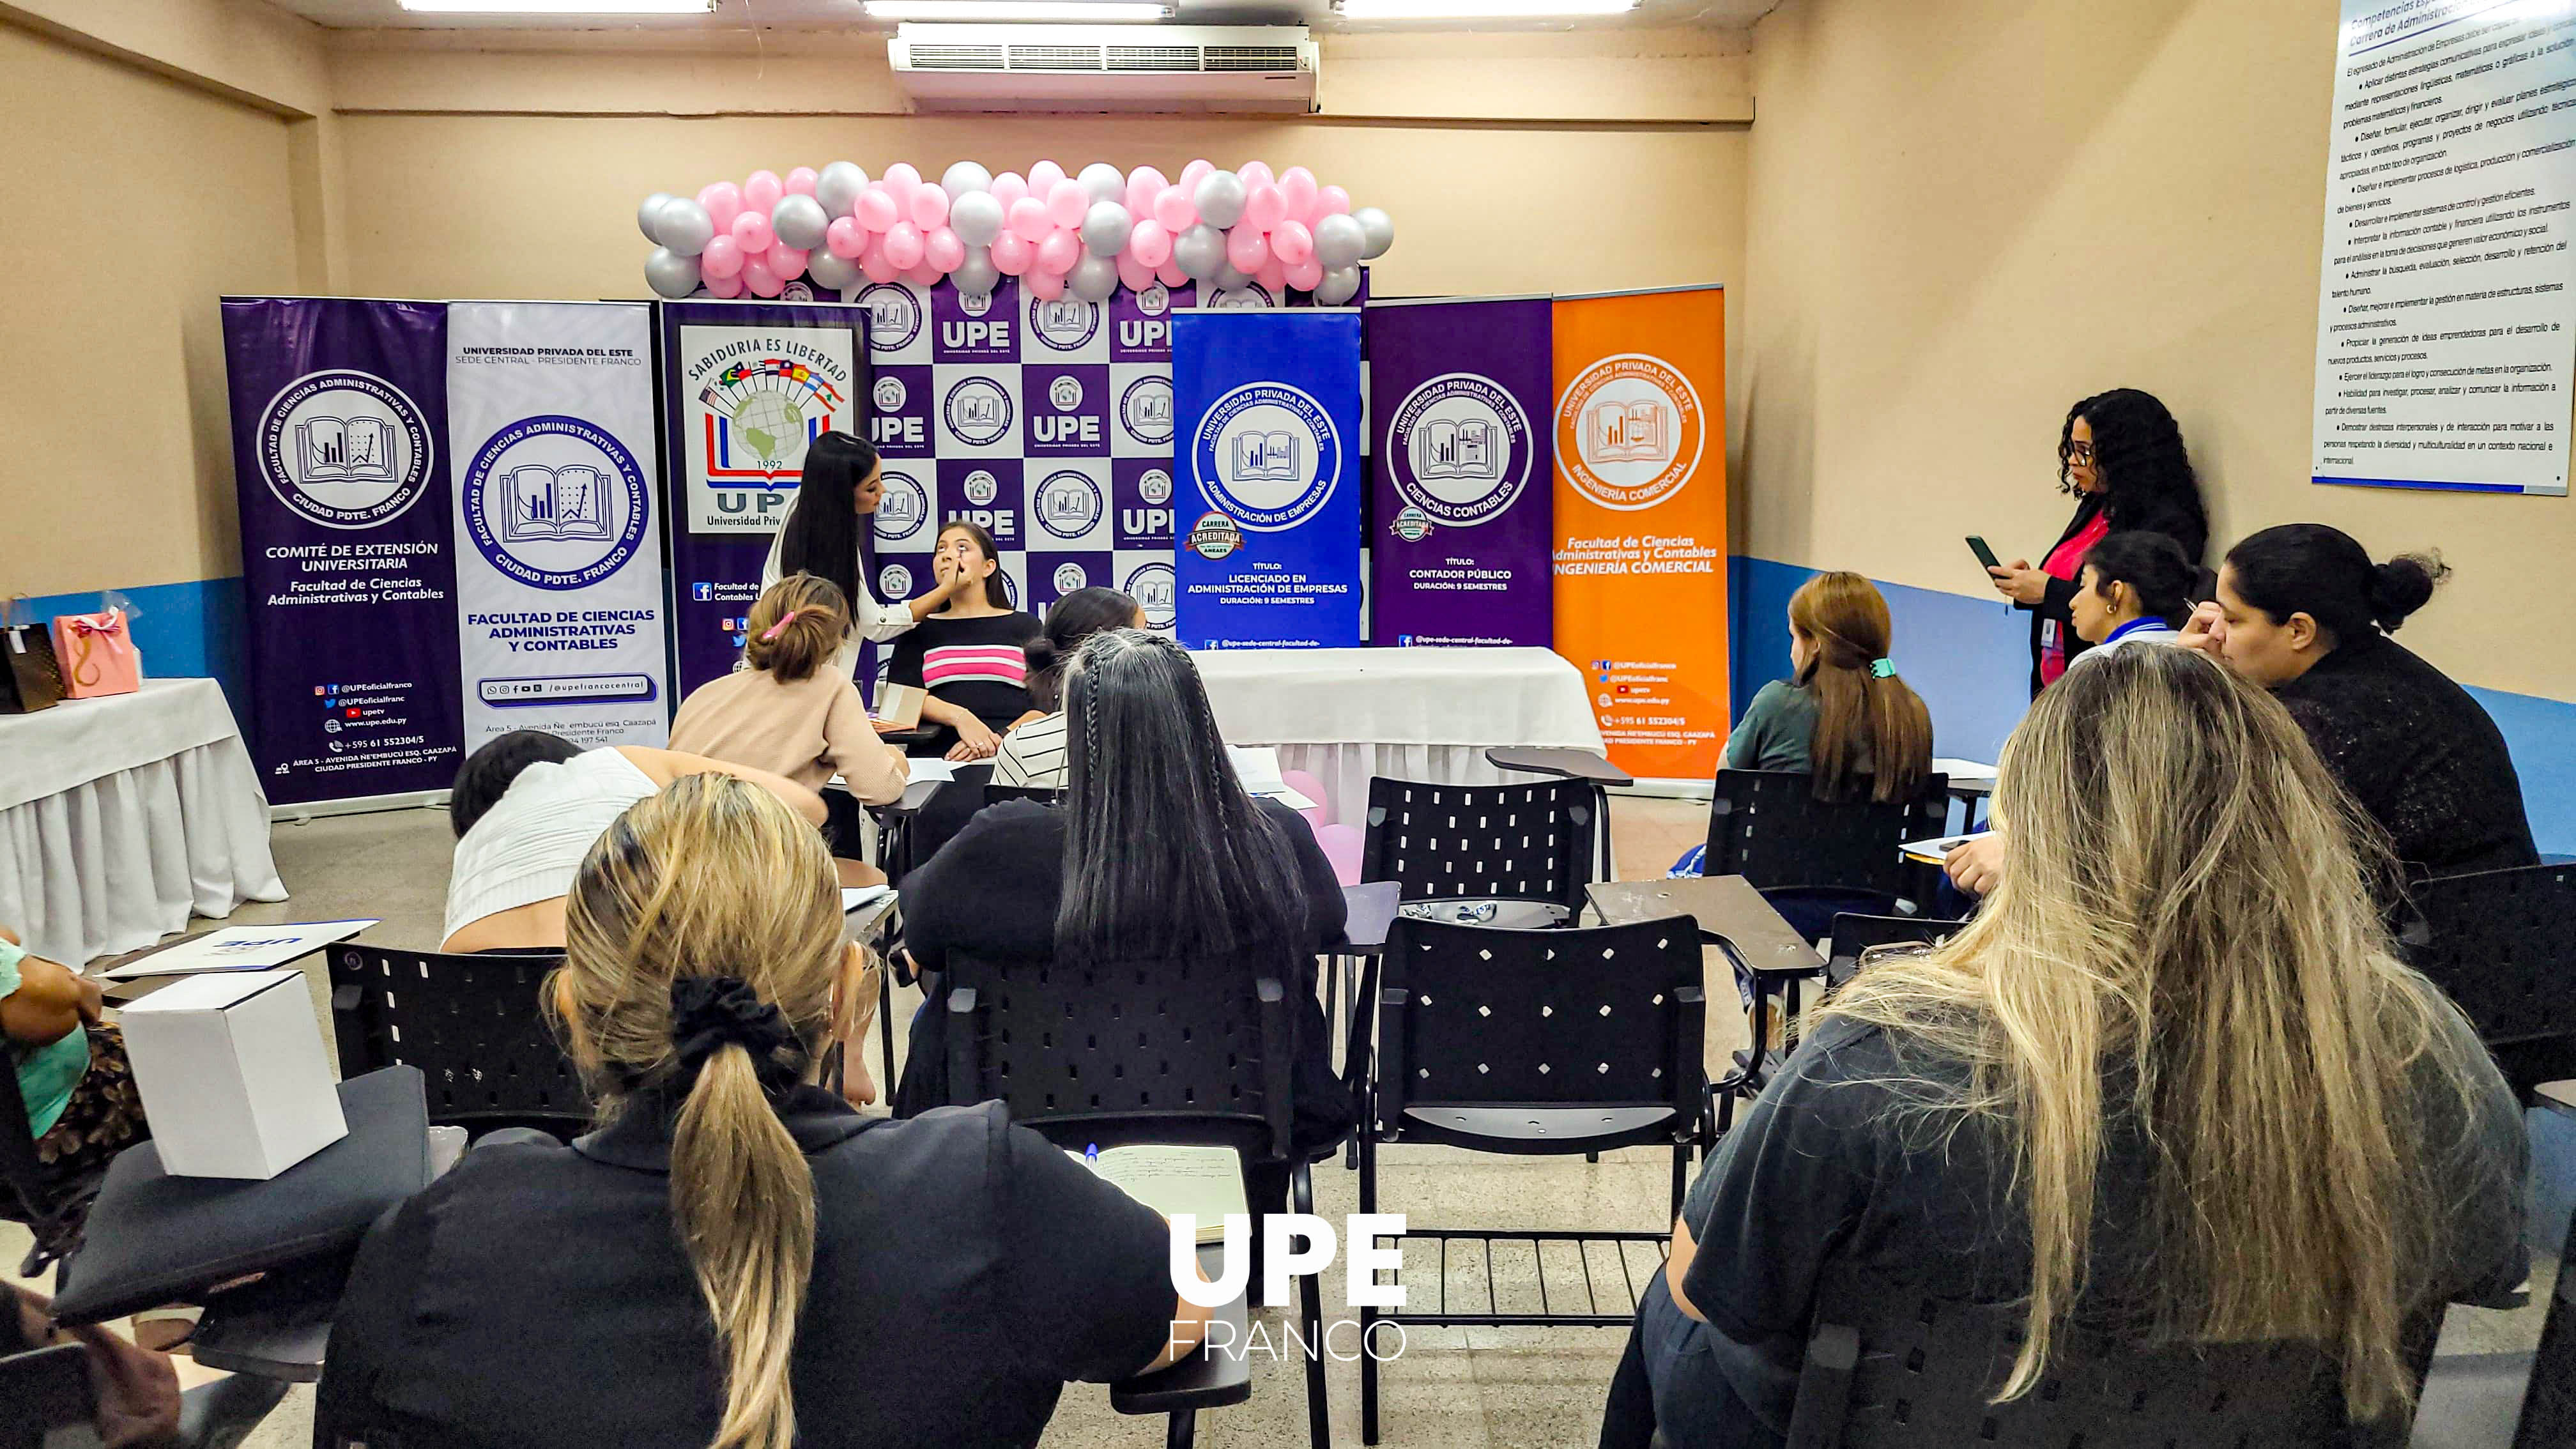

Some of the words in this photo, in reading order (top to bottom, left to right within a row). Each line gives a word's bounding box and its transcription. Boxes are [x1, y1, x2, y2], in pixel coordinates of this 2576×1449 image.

[2350, 29, 2383, 47] Carrera
[2384, 24, 2396, 34] de
[942, 321, 1010, 348] UPE
[2489, 328, 2503, 337] para
[2506, 326, 2512, 334] el
[2516, 323, 2548, 334] desarrollo
[2551, 322, 2560, 331] de
[463, 347, 535, 355] UNIVERSIDAD
[537, 348, 585, 356] PRIVADA
[608, 349, 633, 357] ESTE
[456, 356, 482, 364] SEDE
[538, 357, 599, 365] PRESIDENTE
[601, 358, 641, 366] FRANCO
[688, 339, 761, 381] SABIDURIA
[767, 339, 781, 351] ES
[786, 341, 847, 382] LIBERTAD
[319, 378, 408, 417] ADMINISTRATIVAS
[1563, 366, 1612, 418] UNIVERSIDAD
[1614, 362, 1657, 375] PRIVADA
[1659, 371, 1676, 388] DEL
[1676, 385, 1694, 411] ESTE
[2369, 390, 2380, 398] para
[2469, 385, 2501, 394] comunicar
[2504, 384, 2509, 392] la
[277, 383, 318, 417] CIENCIAS
[1397, 385, 1445, 434] UNIVERSIDAD
[1447, 381, 1488, 395] PRIVADA
[1489, 391, 1505, 407] DEL
[1506, 406, 1522, 433] ESTE
[406, 417, 415, 425] Y
[1203, 392, 1253, 440] UNIVERSIDAD
[1255, 390, 1296, 403] PRIVADA
[1297, 399, 1314, 416] DEL
[1315, 415, 1330, 440] ESTE
[271, 418, 281, 433] DE
[1033, 416, 1100, 441] UPE
[480, 429, 523, 468] CIENCIAS
[526, 422, 625, 466] ADMINISTRATIVAS
[268, 433, 288, 484] FACULTAD
[409, 427, 422, 483] CONTABLES
[622, 463, 632, 473] Y
[757, 461, 782, 470] 1992
[473, 471, 484, 486] DE
[1572, 464, 1627, 501] INGENIERÍA
[1629, 462, 1687, 501] COMERCIAL
[292, 493, 334, 518] CIUDAD
[337, 510, 371, 521] PDTE.
[373, 487, 411, 517] FRANCO
[717, 493, 785, 513] UP
[1207, 480, 1272, 523] ADMINISTRACIÓN
[1274, 512, 1287, 522] DE
[1289, 479, 1326, 519] EMPRESAS
[1406, 482, 1451, 517] CIENCIAS
[1453, 481, 1513, 518] CONTABLES
[625, 475, 641, 541] CONTABLES
[471, 488, 493, 546] FACULTAD
[707, 516, 760, 525] Universidad
[764, 516, 781, 525] Priv
[1192, 532, 1239, 544] ACREDITADA
[1567, 537, 1620, 549] Facultad
[1623, 536, 1639, 547] de
[1642, 535, 1694, 548] Ciencias
[266, 542, 327, 558] COMITÉ
[331, 546, 351, 557] DE
[355, 540, 438, 556] EXTENSIÓN
[1643, 550, 1651, 561] y
[1653, 547, 1717, 558] Contables
[302, 558, 408, 572] UNIVERSITARIA
[495, 554, 540, 582] CIUDAD
[544, 574, 582, 585] PDTE.
[583, 546, 627, 581] FRANCO
[1553, 560, 1628, 575] NGENIERÍA
[1631, 561, 1713, 573] COMERCIAL
[1229, 574, 1289, 583] LICENCIADO
[1292, 574, 1306, 583] EN
[1409, 569, 1464, 579] CONTADOR
[1468, 568, 1512, 579] PÚBLICO
[290, 579, 346, 592] Facultad
[350, 579, 366, 590] de
[370, 578, 422, 589] Ciencias
[714, 583, 747, 591] Facultad
[1188, 582, 1275, 594] ADMINISTRACIÓN
[1278, 585, 1291, 594] DE
[1294, 585, 1347, 593] EMPRESAS
[267, 592, 368, 606] Administrativas
[371, 593, 379, 604] y
[382, 588, 444, 601] Contables
[1220, 596, 1262, 604] DURACIÓN:
[468, 613, 551, 625] FACULTAD
[556, 611, 578, 622] DE
[582, 610, 655, 622] CIENCIAS
[489, 624, 636, 638] ADMINISTRATIVAS
[509, 641, 521, 652] Y
[524, 639, 618, 652] CONTABLES
[341, 681, 413, 693] @UPEoficialfranco
[338, 695, 405, 707] @UPEoficialfranc
[362, 708, 385, 716] upetv
[623, 718, 657, 727] Caazapá
[345, 740, 368, 749] +595
[370, 739, 381, 747] 61
[383, 735, 424, 746] 552304/5
[315, 763, 345, 772] CIUDAD
[346, 760, 391, 770] PRESIDENTE
[392, 756, 422, 766] FRANCO
[325, 755, 359, 764] AVENIDA
[405, 749, 422, 758] ESQ.
